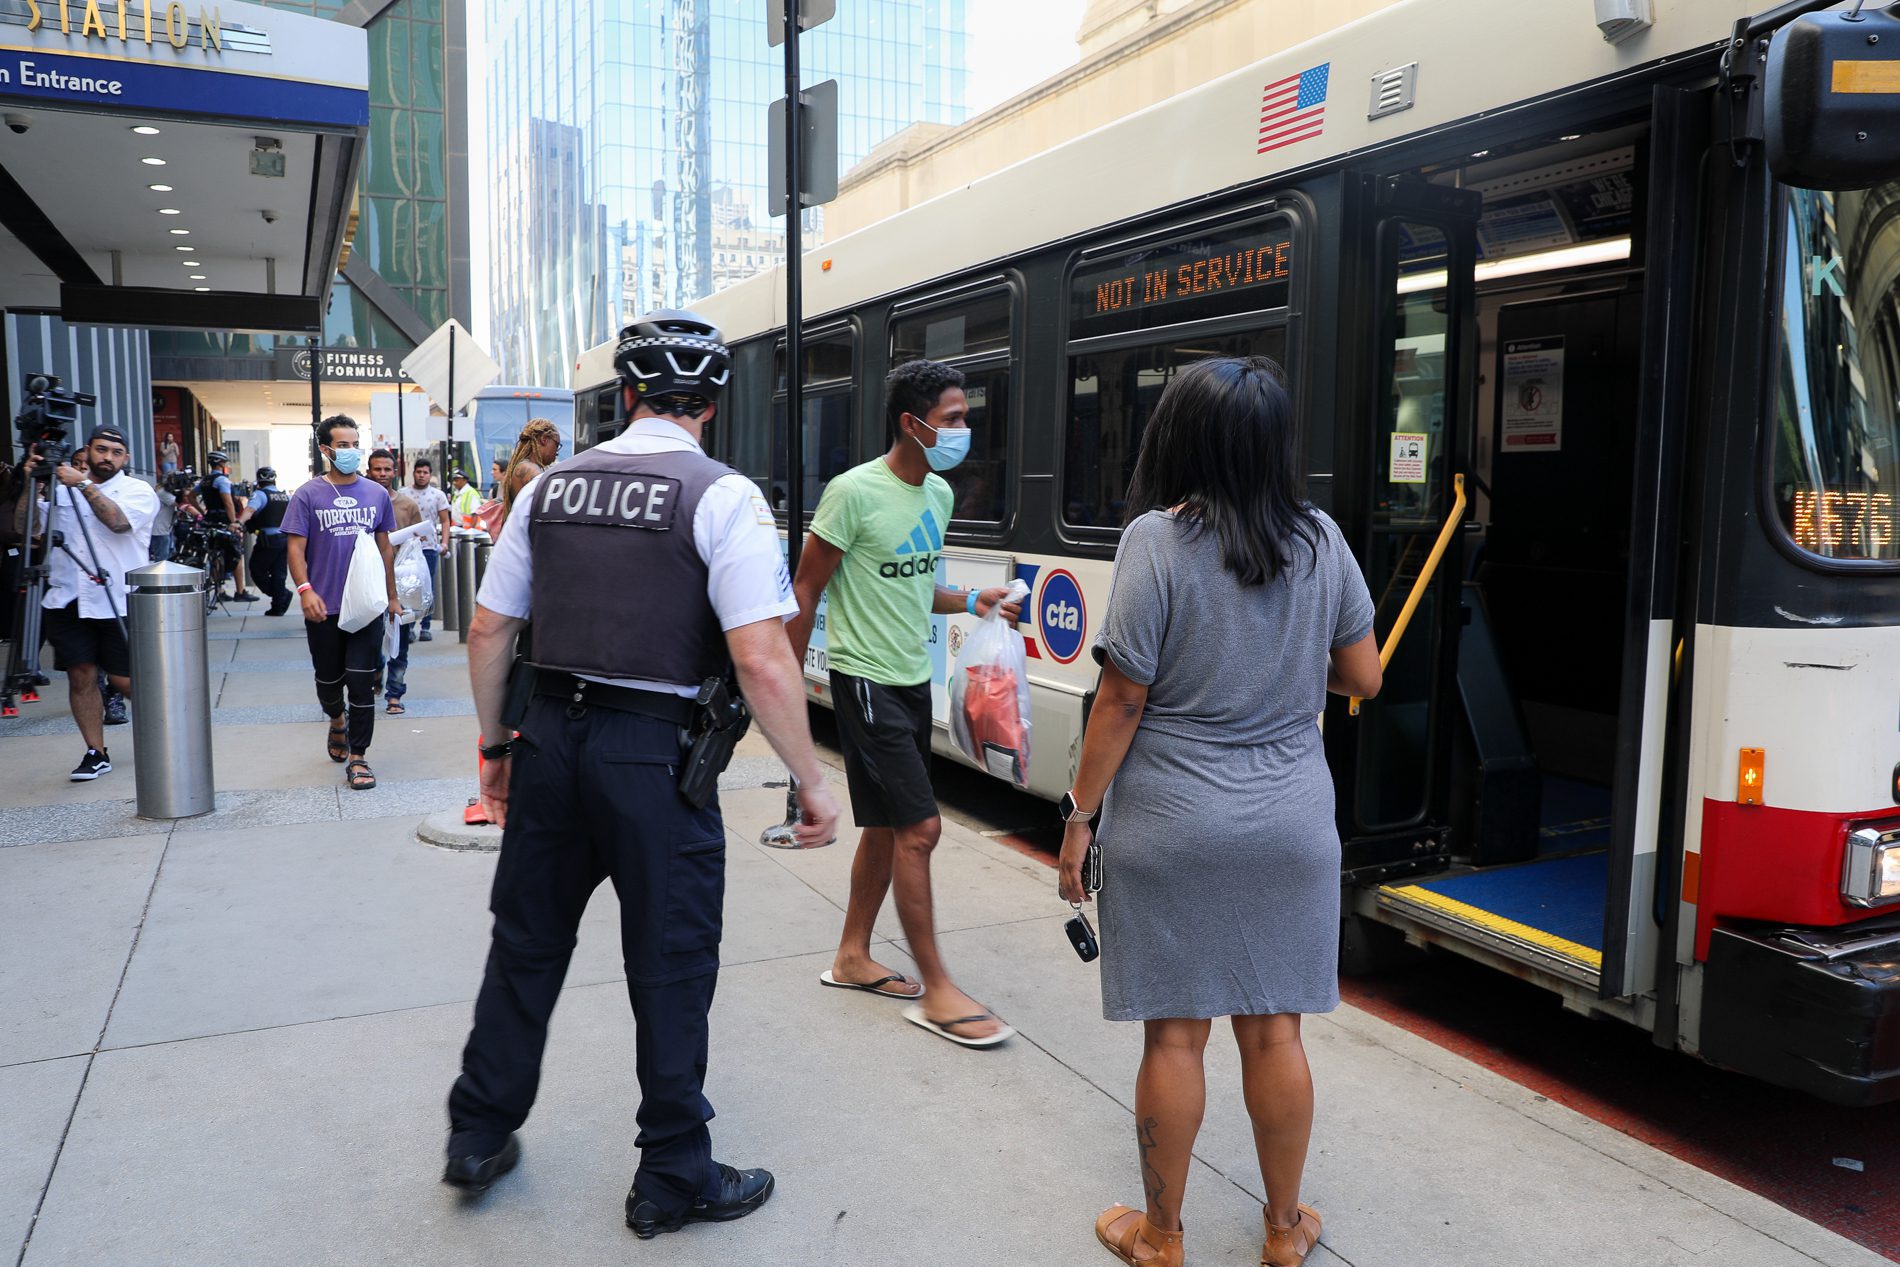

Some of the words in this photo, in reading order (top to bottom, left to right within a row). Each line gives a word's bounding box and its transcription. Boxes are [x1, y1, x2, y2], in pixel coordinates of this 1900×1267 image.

[19, 60, 123, 96] Entrance
[1096, 277, 1135, 312] NOT
[1144, 269, 1168, 303] IN
[1176, 241, 1291, 297] SERVICE
[1812, 255, 1845, 297] K
[326, 353, 384, 365] FITNESS
[326, 366, 393, 378] FORMULA
[541, 477, 670, 522] POLICE
[315, 506, 377, 532] YORKVILLE
[1046, 600, 1079, 631] cta
